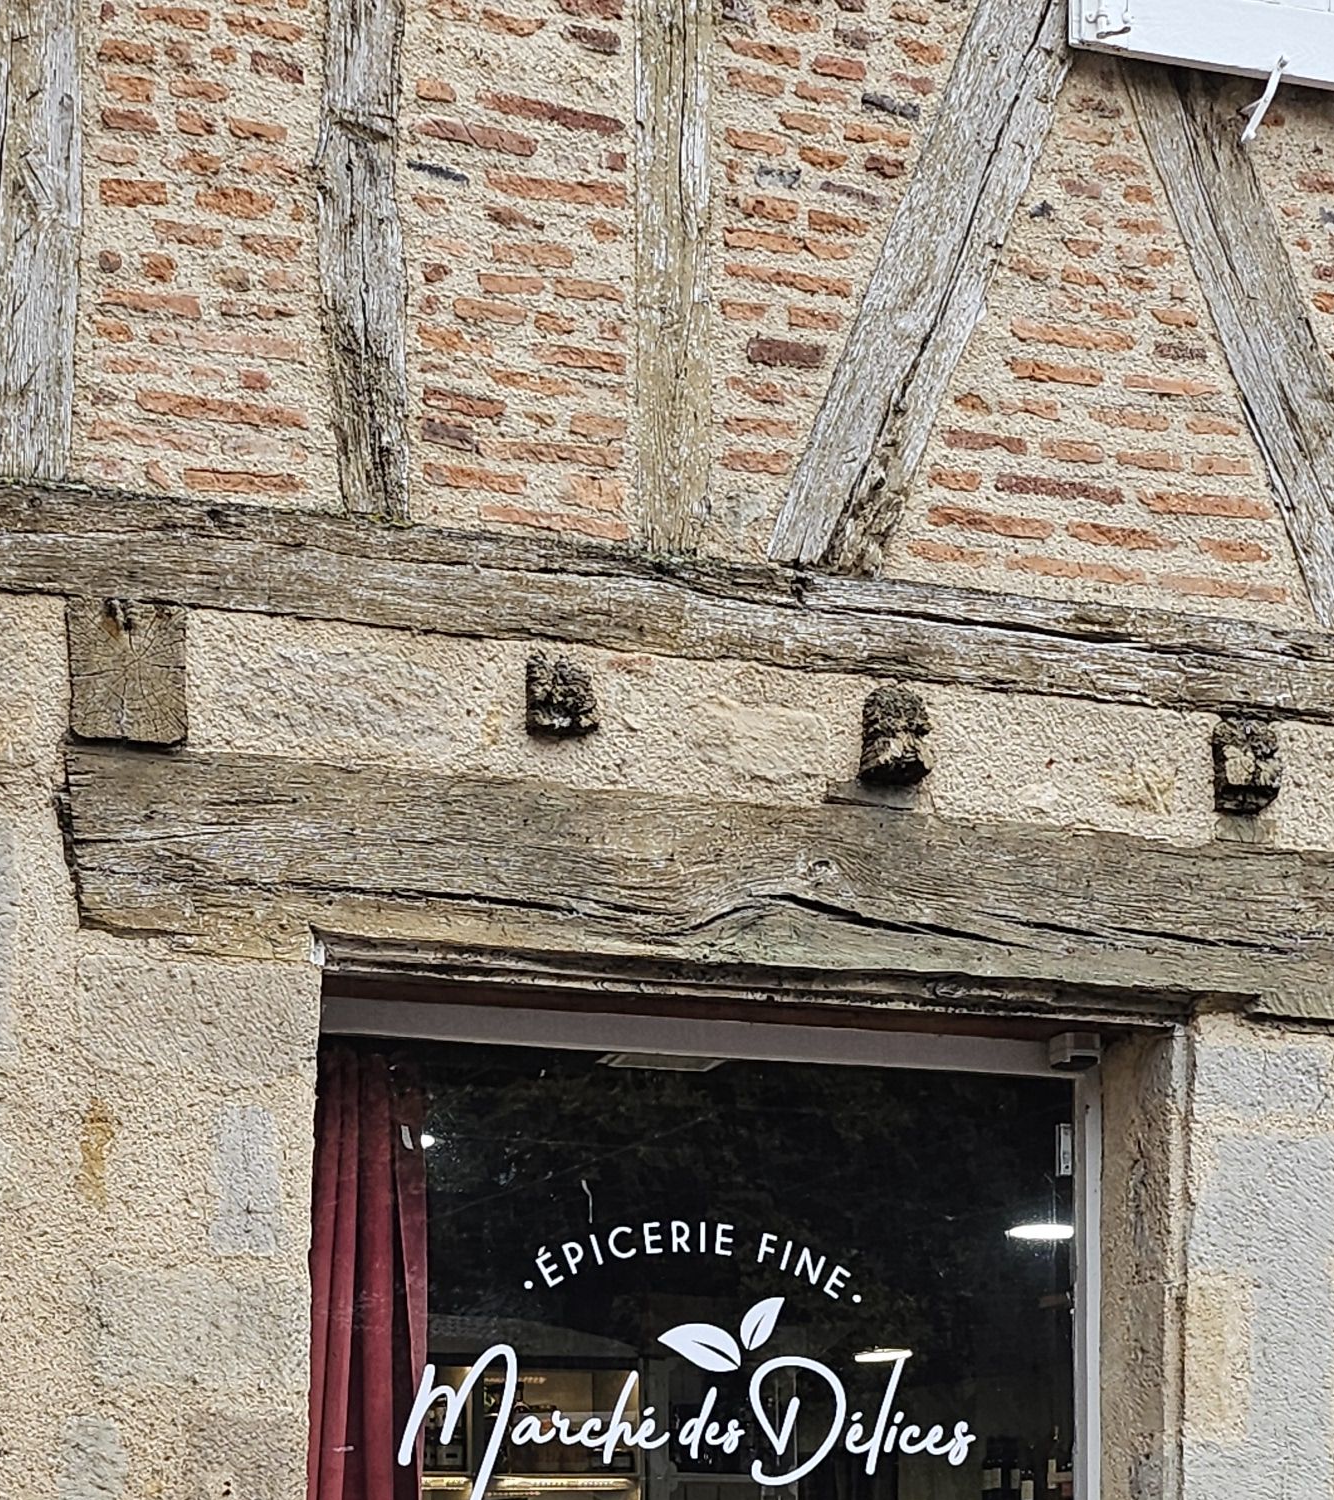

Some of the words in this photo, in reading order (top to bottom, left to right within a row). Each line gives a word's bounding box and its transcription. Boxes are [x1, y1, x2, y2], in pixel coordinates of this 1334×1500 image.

[534, 1221, 734, 1290] ÉPICERIE
[756, 1232, 851, 1300] FINE
[679, 1386, 746, 1460] des
[749, 1355, 977, 1486] Délices
